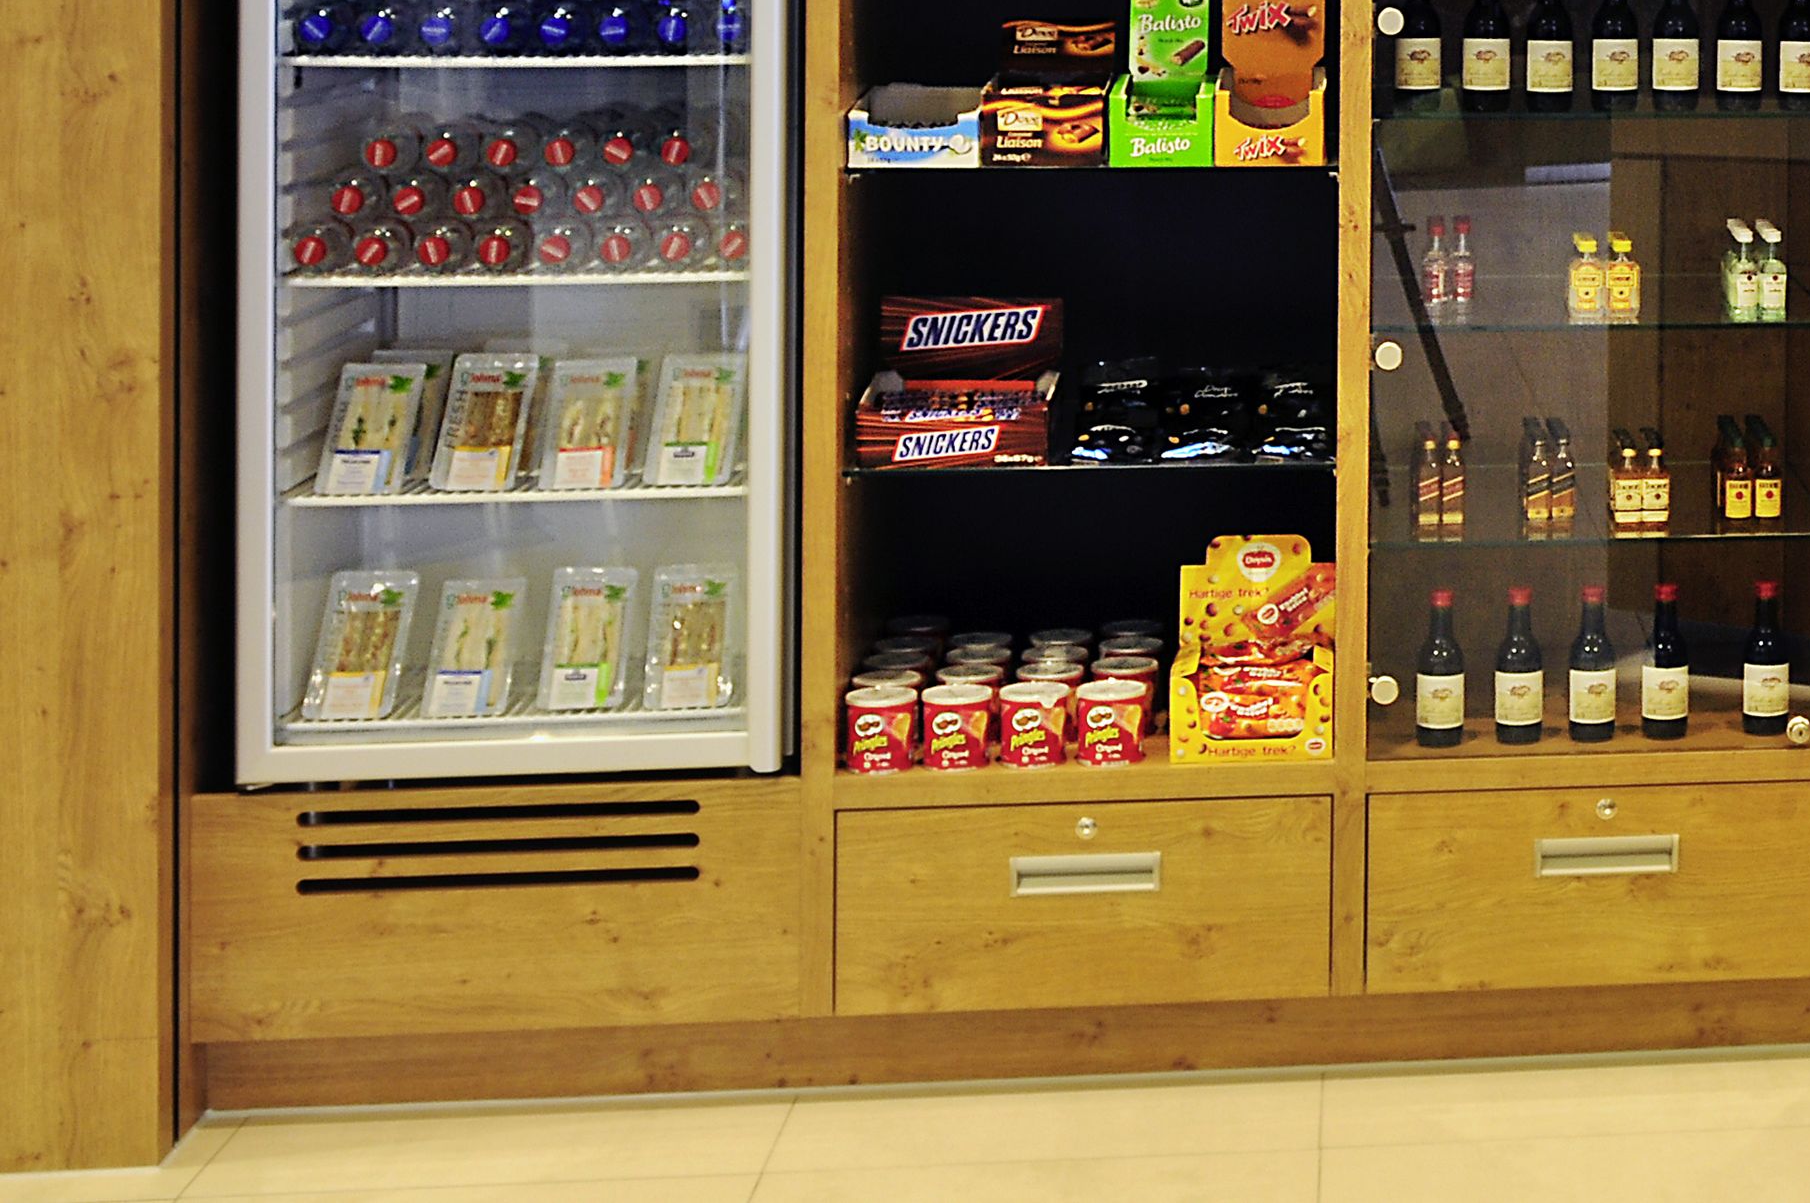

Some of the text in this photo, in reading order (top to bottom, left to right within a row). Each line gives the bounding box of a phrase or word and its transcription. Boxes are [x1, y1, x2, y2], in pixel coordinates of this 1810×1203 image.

[1137, 13, 1202, 34] Balisto
[1013, 44, 1057, 55] Liaison
[866, 134, 944, 153] BOUNTY
[996, 135, 1043, 149] Liaison
[1130, 136, 1192, 158] Balisto
[906, 309, 1039, 348] SNICKERS
[899, 428, 996, 458] SNICKERS
[1189, 588, 1233, 601] Hartige
[1208, 746, 1256, 758] Hartige
